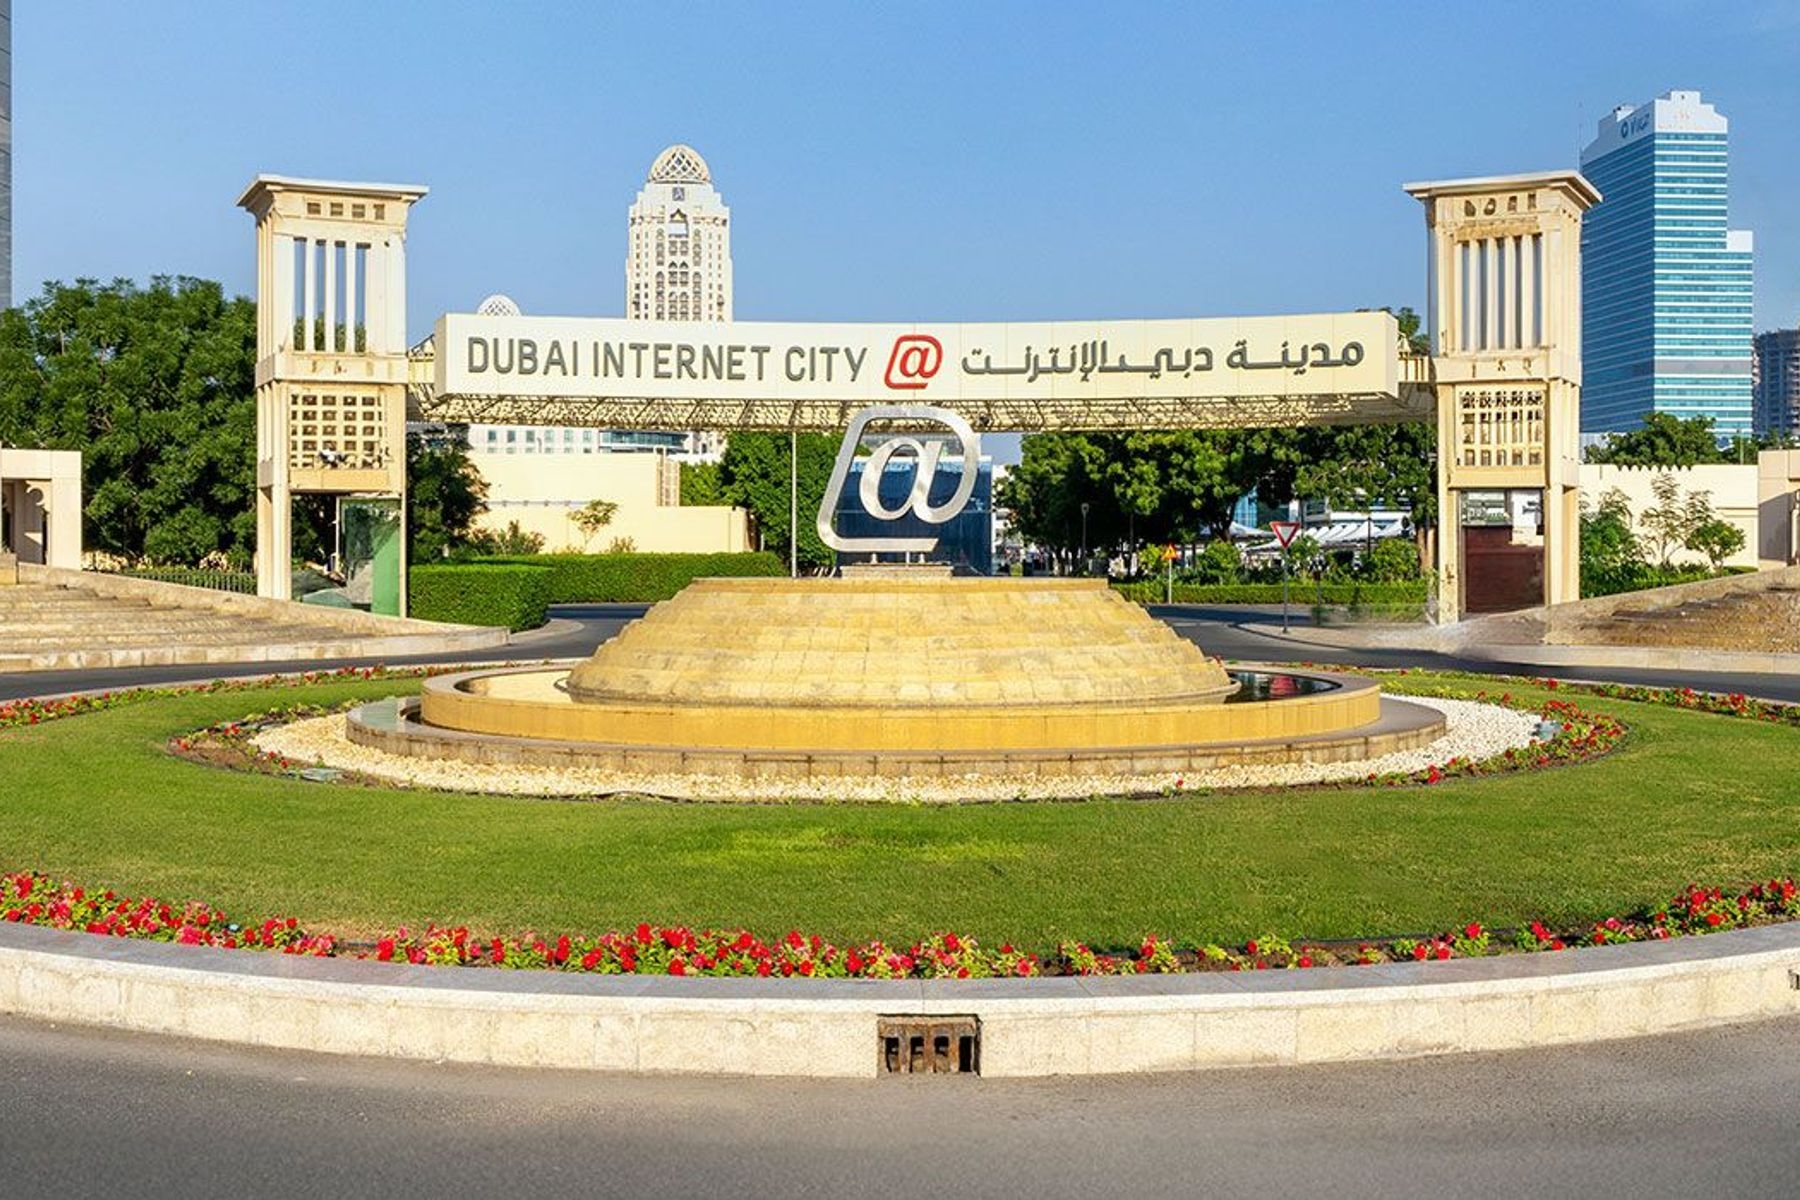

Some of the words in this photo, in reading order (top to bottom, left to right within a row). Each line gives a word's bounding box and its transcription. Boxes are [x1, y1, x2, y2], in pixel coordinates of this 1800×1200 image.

[467, 336, 579, 376] DUBAI
[593, 340, 771, 381] INTERNET
[784, 345, 868, 383] CITY
[1226, 338, 1364, 376] مدينة
